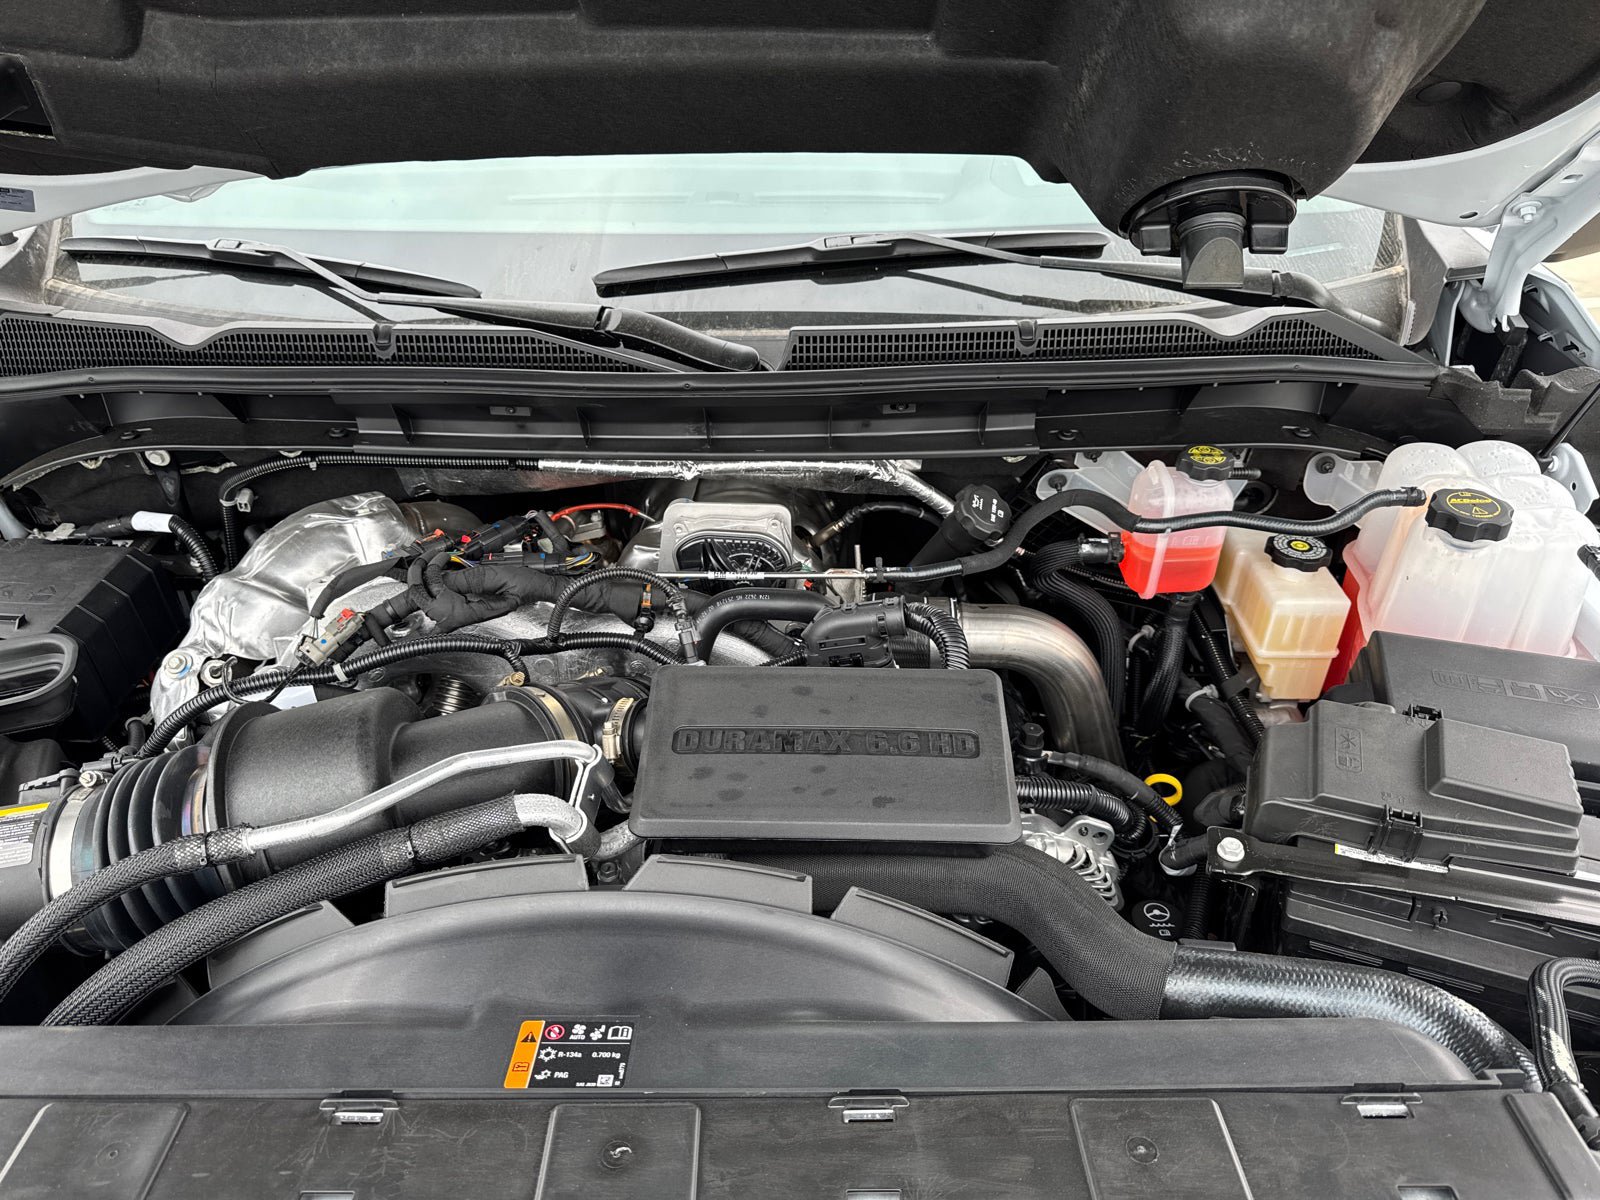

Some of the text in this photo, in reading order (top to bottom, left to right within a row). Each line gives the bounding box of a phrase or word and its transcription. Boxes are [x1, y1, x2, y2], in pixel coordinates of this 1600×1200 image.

[677, 729, 977, 757] DURAMAX 6.6 HD
[611, 1051, 621, 1059] kg
[553, 1071, 569, 1079] PAG
